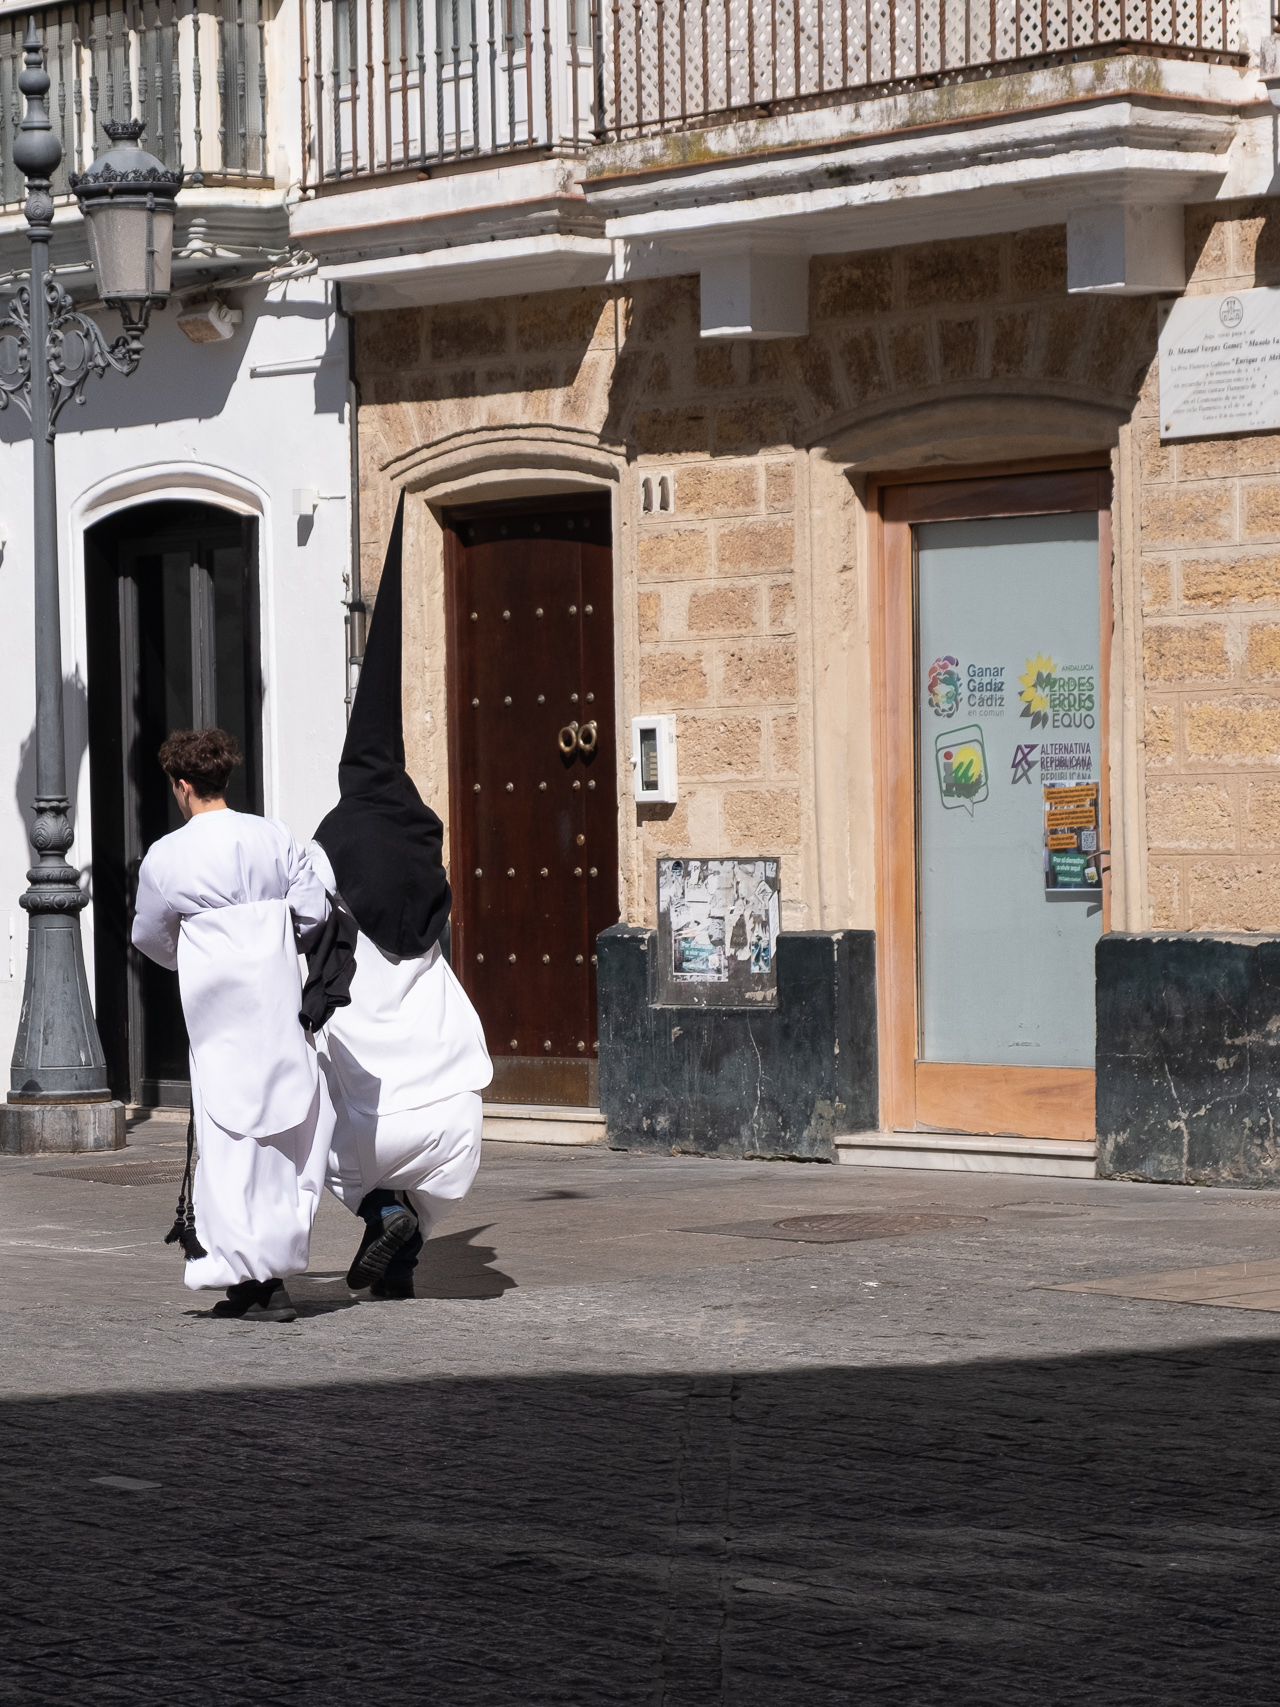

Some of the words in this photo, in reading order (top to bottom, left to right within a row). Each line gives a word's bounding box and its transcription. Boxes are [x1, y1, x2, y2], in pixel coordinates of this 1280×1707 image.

[642, 475, 670, 512] 11
[967, 664, 1005, 677] Ganar
[1052, 713, 1095, 729] EQUO
[1040, 743, 1091, 755] ALTERNATIVA
[1040, 755, 1092, 768] REPUBLICANA
